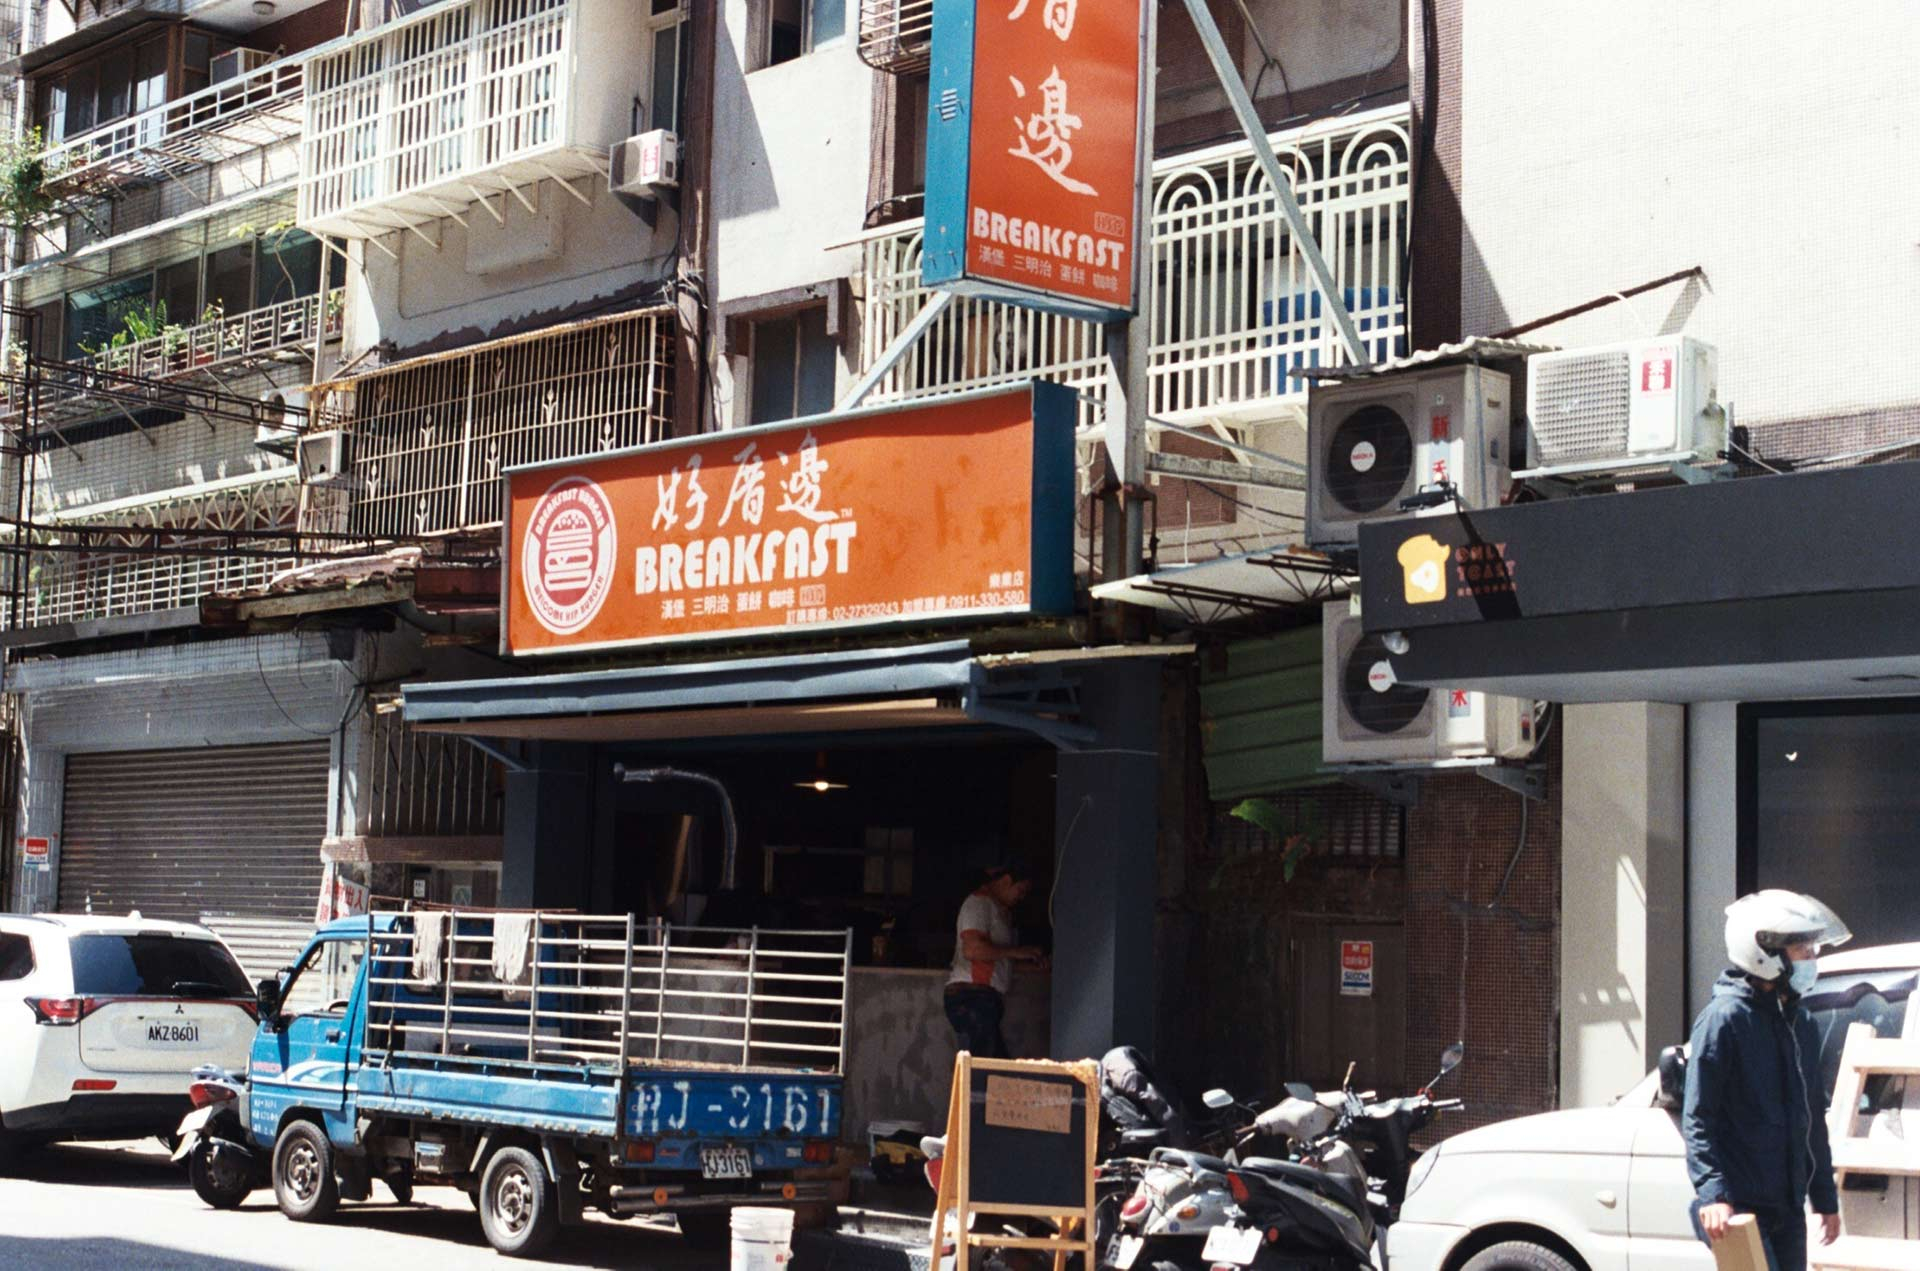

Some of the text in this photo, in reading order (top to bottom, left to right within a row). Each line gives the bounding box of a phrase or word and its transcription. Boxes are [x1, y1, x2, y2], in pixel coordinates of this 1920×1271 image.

[973, 207, 1125, 271] BREAKFAST
[1013, 254, 1052, 278] 三明治
[635, 520, 858, 595] BREAKFAST
[692, 594, 729, 616] 三明治
